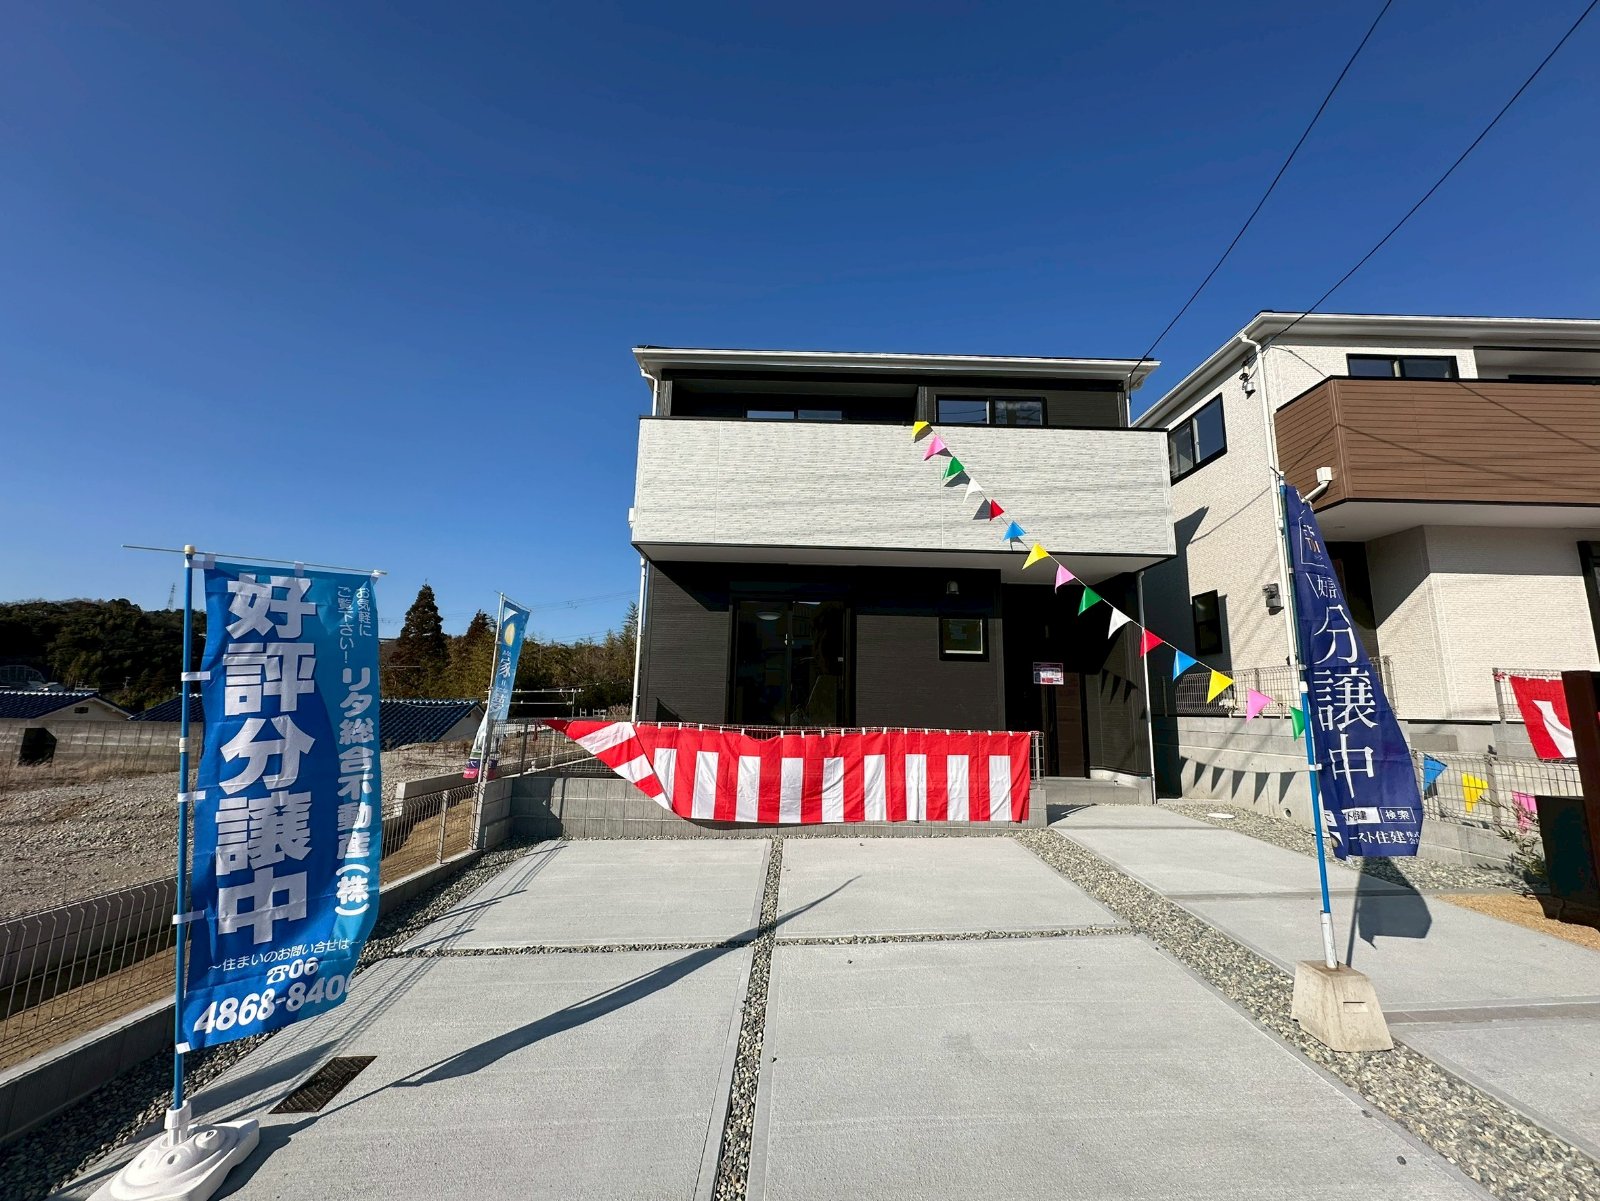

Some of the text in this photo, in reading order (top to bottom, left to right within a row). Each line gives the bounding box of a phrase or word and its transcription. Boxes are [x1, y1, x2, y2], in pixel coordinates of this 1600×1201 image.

[356, 587, 373, 638] お気軽に
[1313, 605, 1378, 798] 分譲中
[215, 573, 317, 945] 好評分譲中
[1385, 809, 1411, 820] 検索
[288, 956, 319, 981] 06
